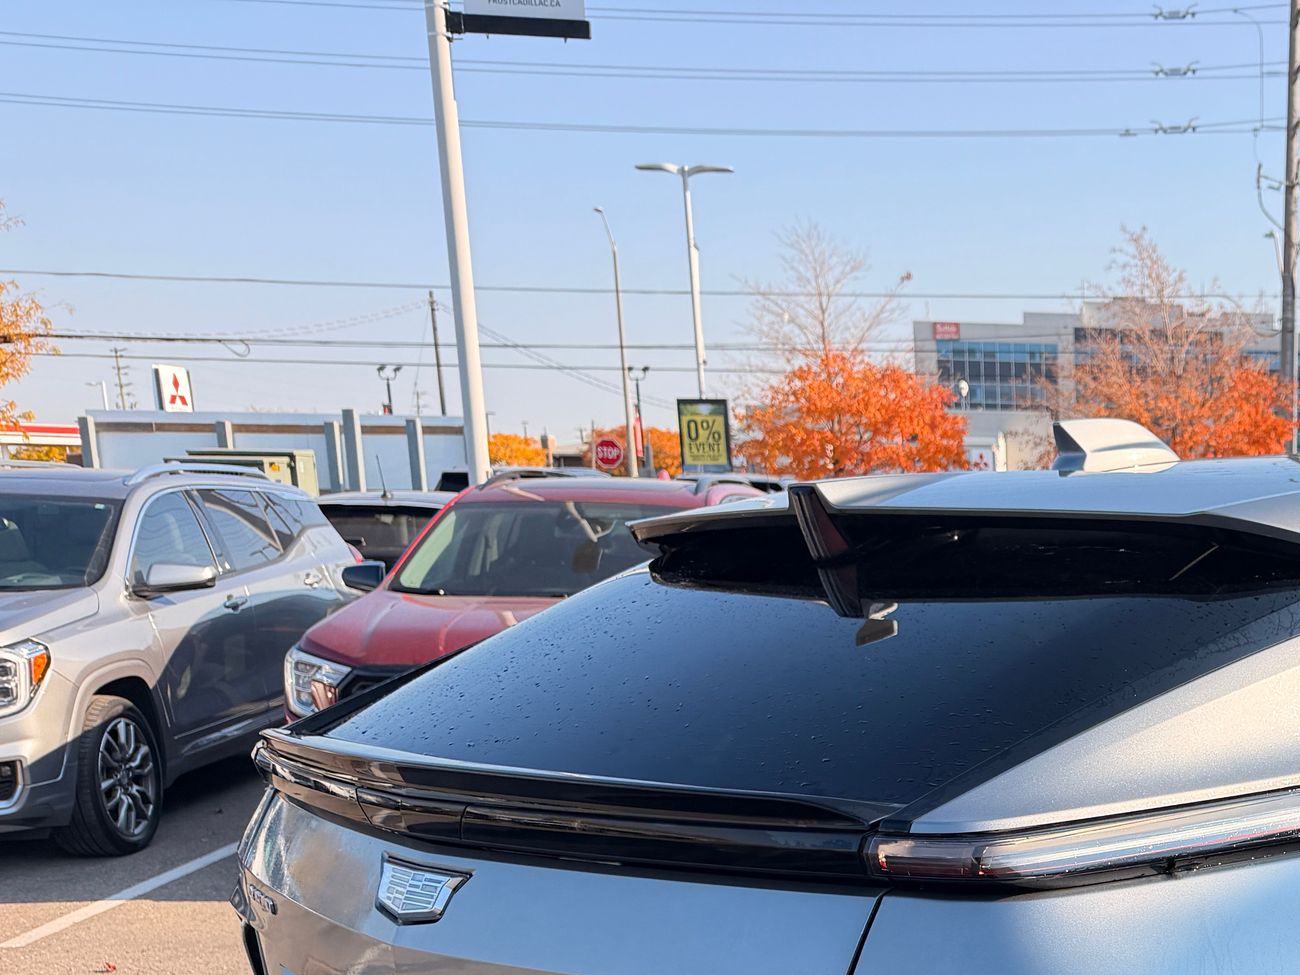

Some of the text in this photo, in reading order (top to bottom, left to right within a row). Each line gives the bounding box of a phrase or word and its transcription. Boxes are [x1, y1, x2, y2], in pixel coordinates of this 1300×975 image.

[687, 418, 722, 443] 0%
[597, 446, 620, 459] STOP
[688, 442, 721, 454] EVENT
